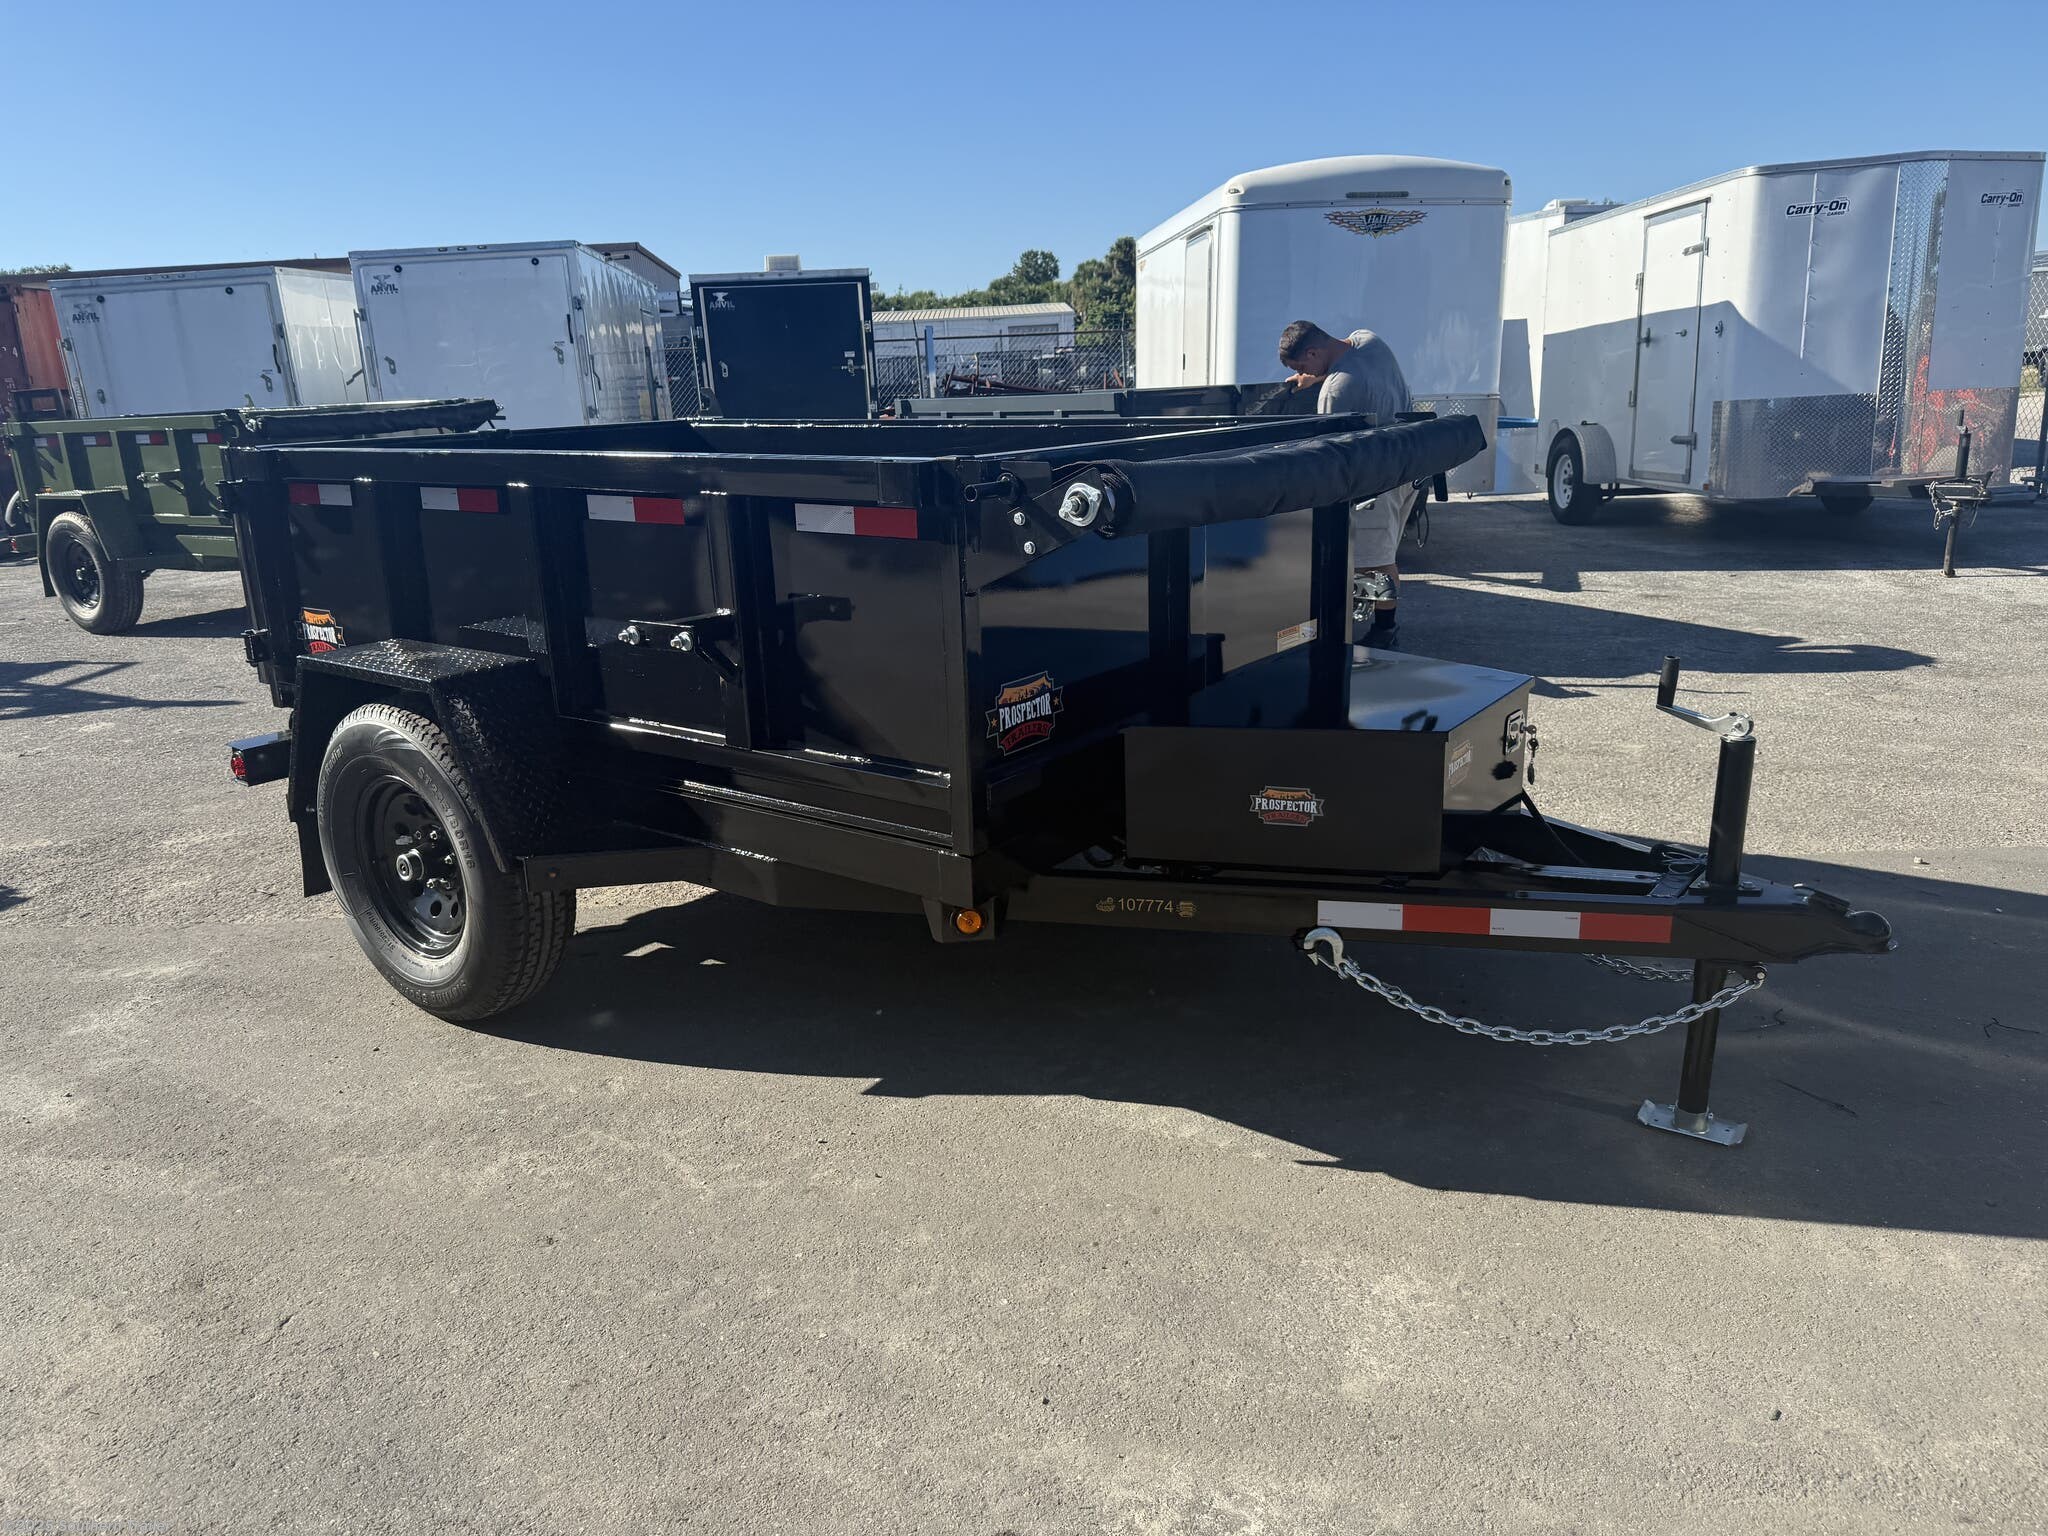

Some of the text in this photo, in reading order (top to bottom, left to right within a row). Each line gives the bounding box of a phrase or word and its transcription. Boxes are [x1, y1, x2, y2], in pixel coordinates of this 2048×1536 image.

[1981, 192, 2023, 205] Carry-On
[1786, 200, 1848, 216] Carry-On
[370, 283, 399, 294] ANVIL
[998, 692, 1053, 733] PROSPECTOR
[1254, 797, 1319, 814] PROSPECTOR
[1117, 897, 1174, 913] 107774
